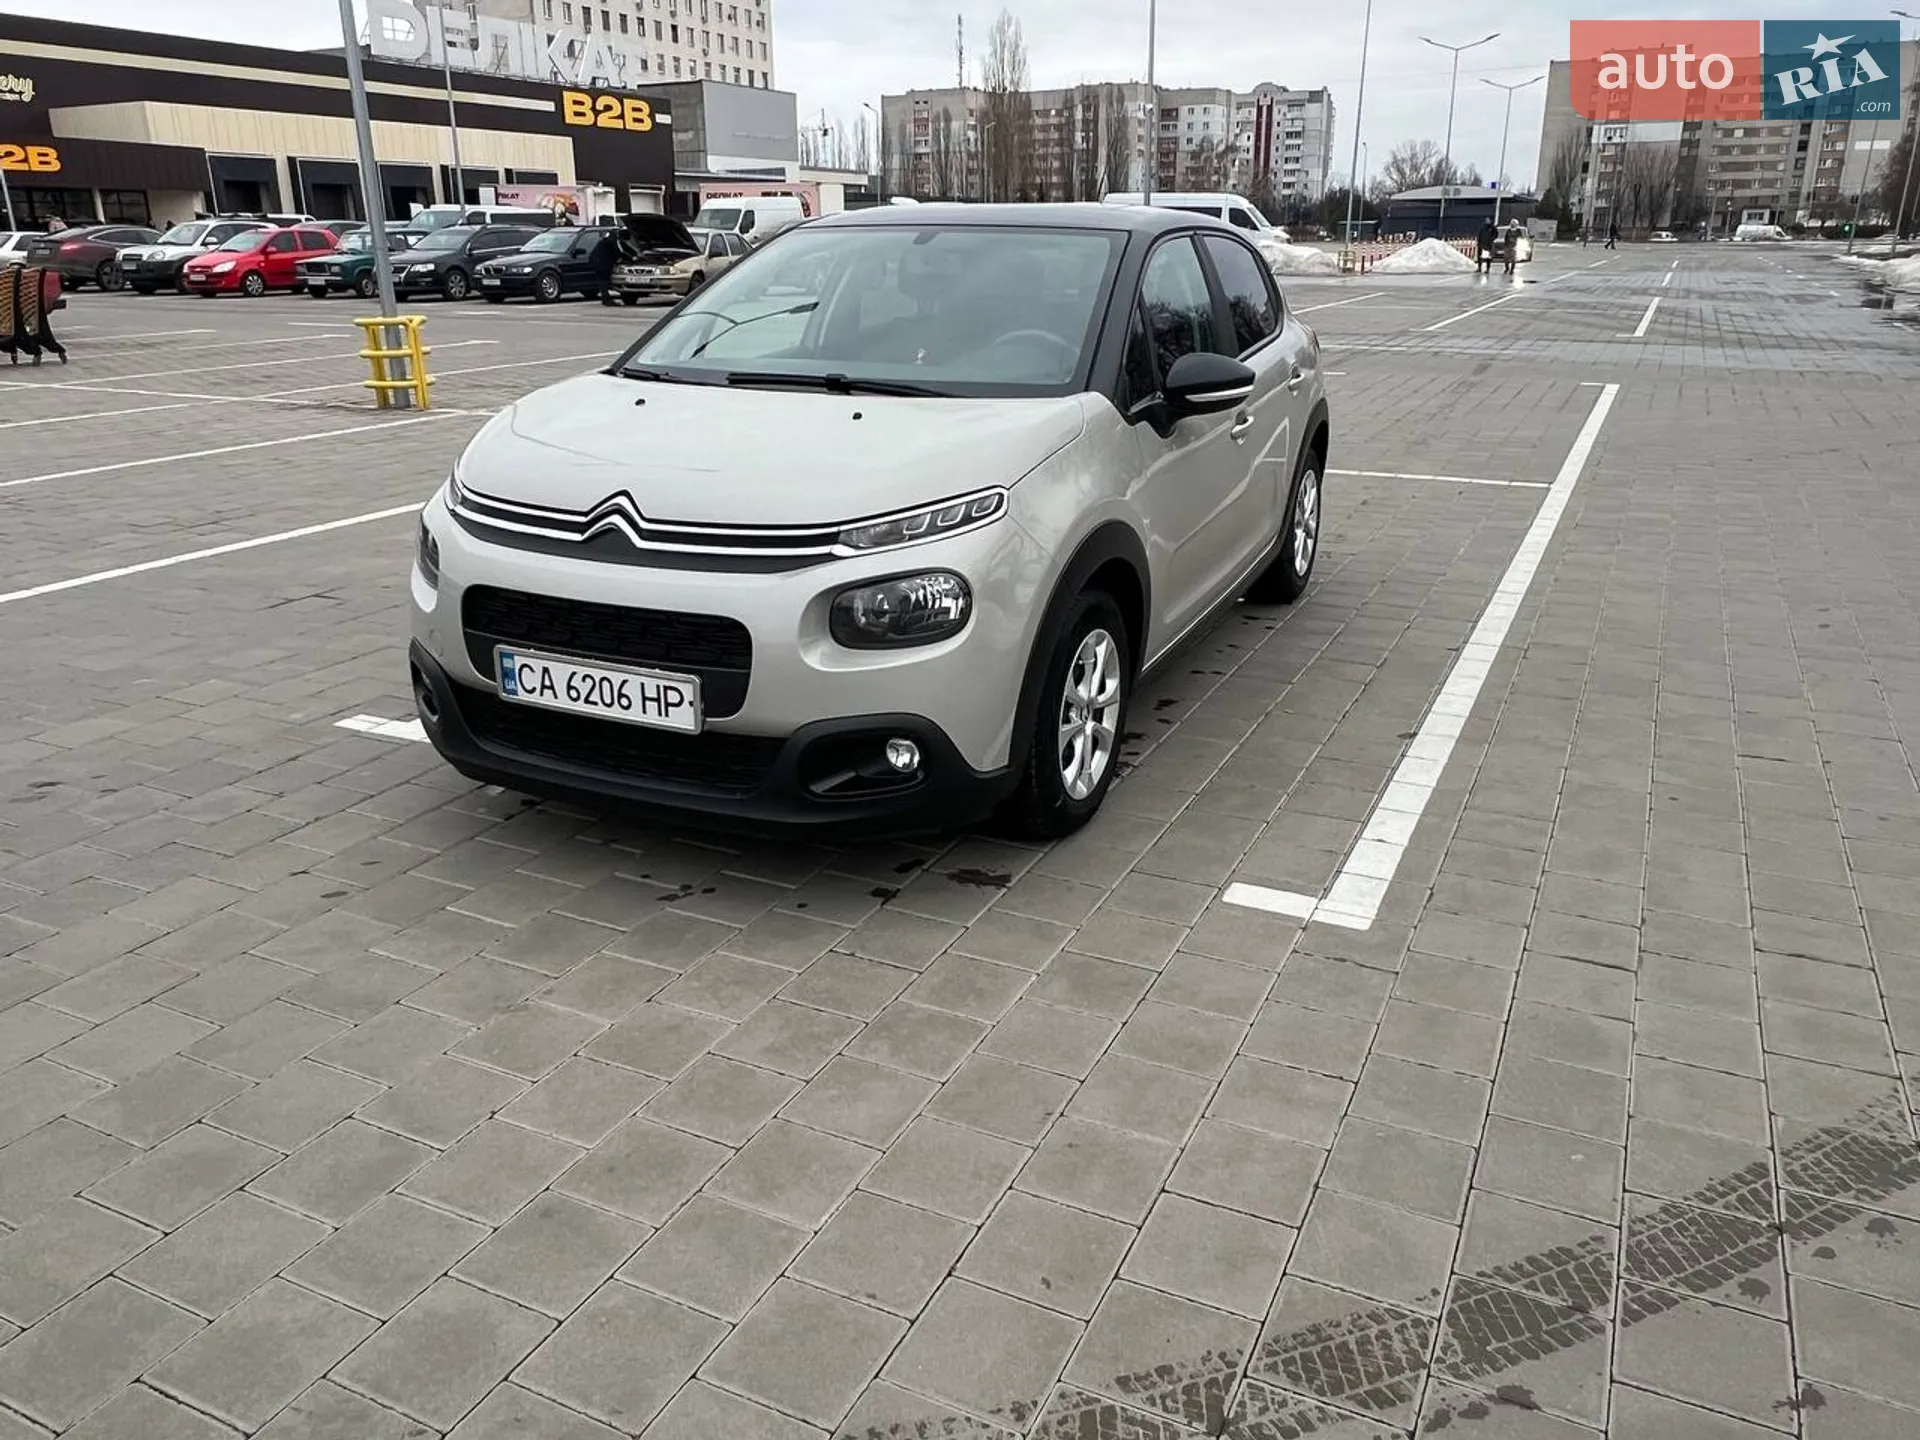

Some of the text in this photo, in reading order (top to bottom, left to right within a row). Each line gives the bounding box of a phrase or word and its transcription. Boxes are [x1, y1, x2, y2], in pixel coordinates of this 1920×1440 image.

[562, 90, 652, 132] B2B
[518, 663, 685, 717] CA 6206 HP
